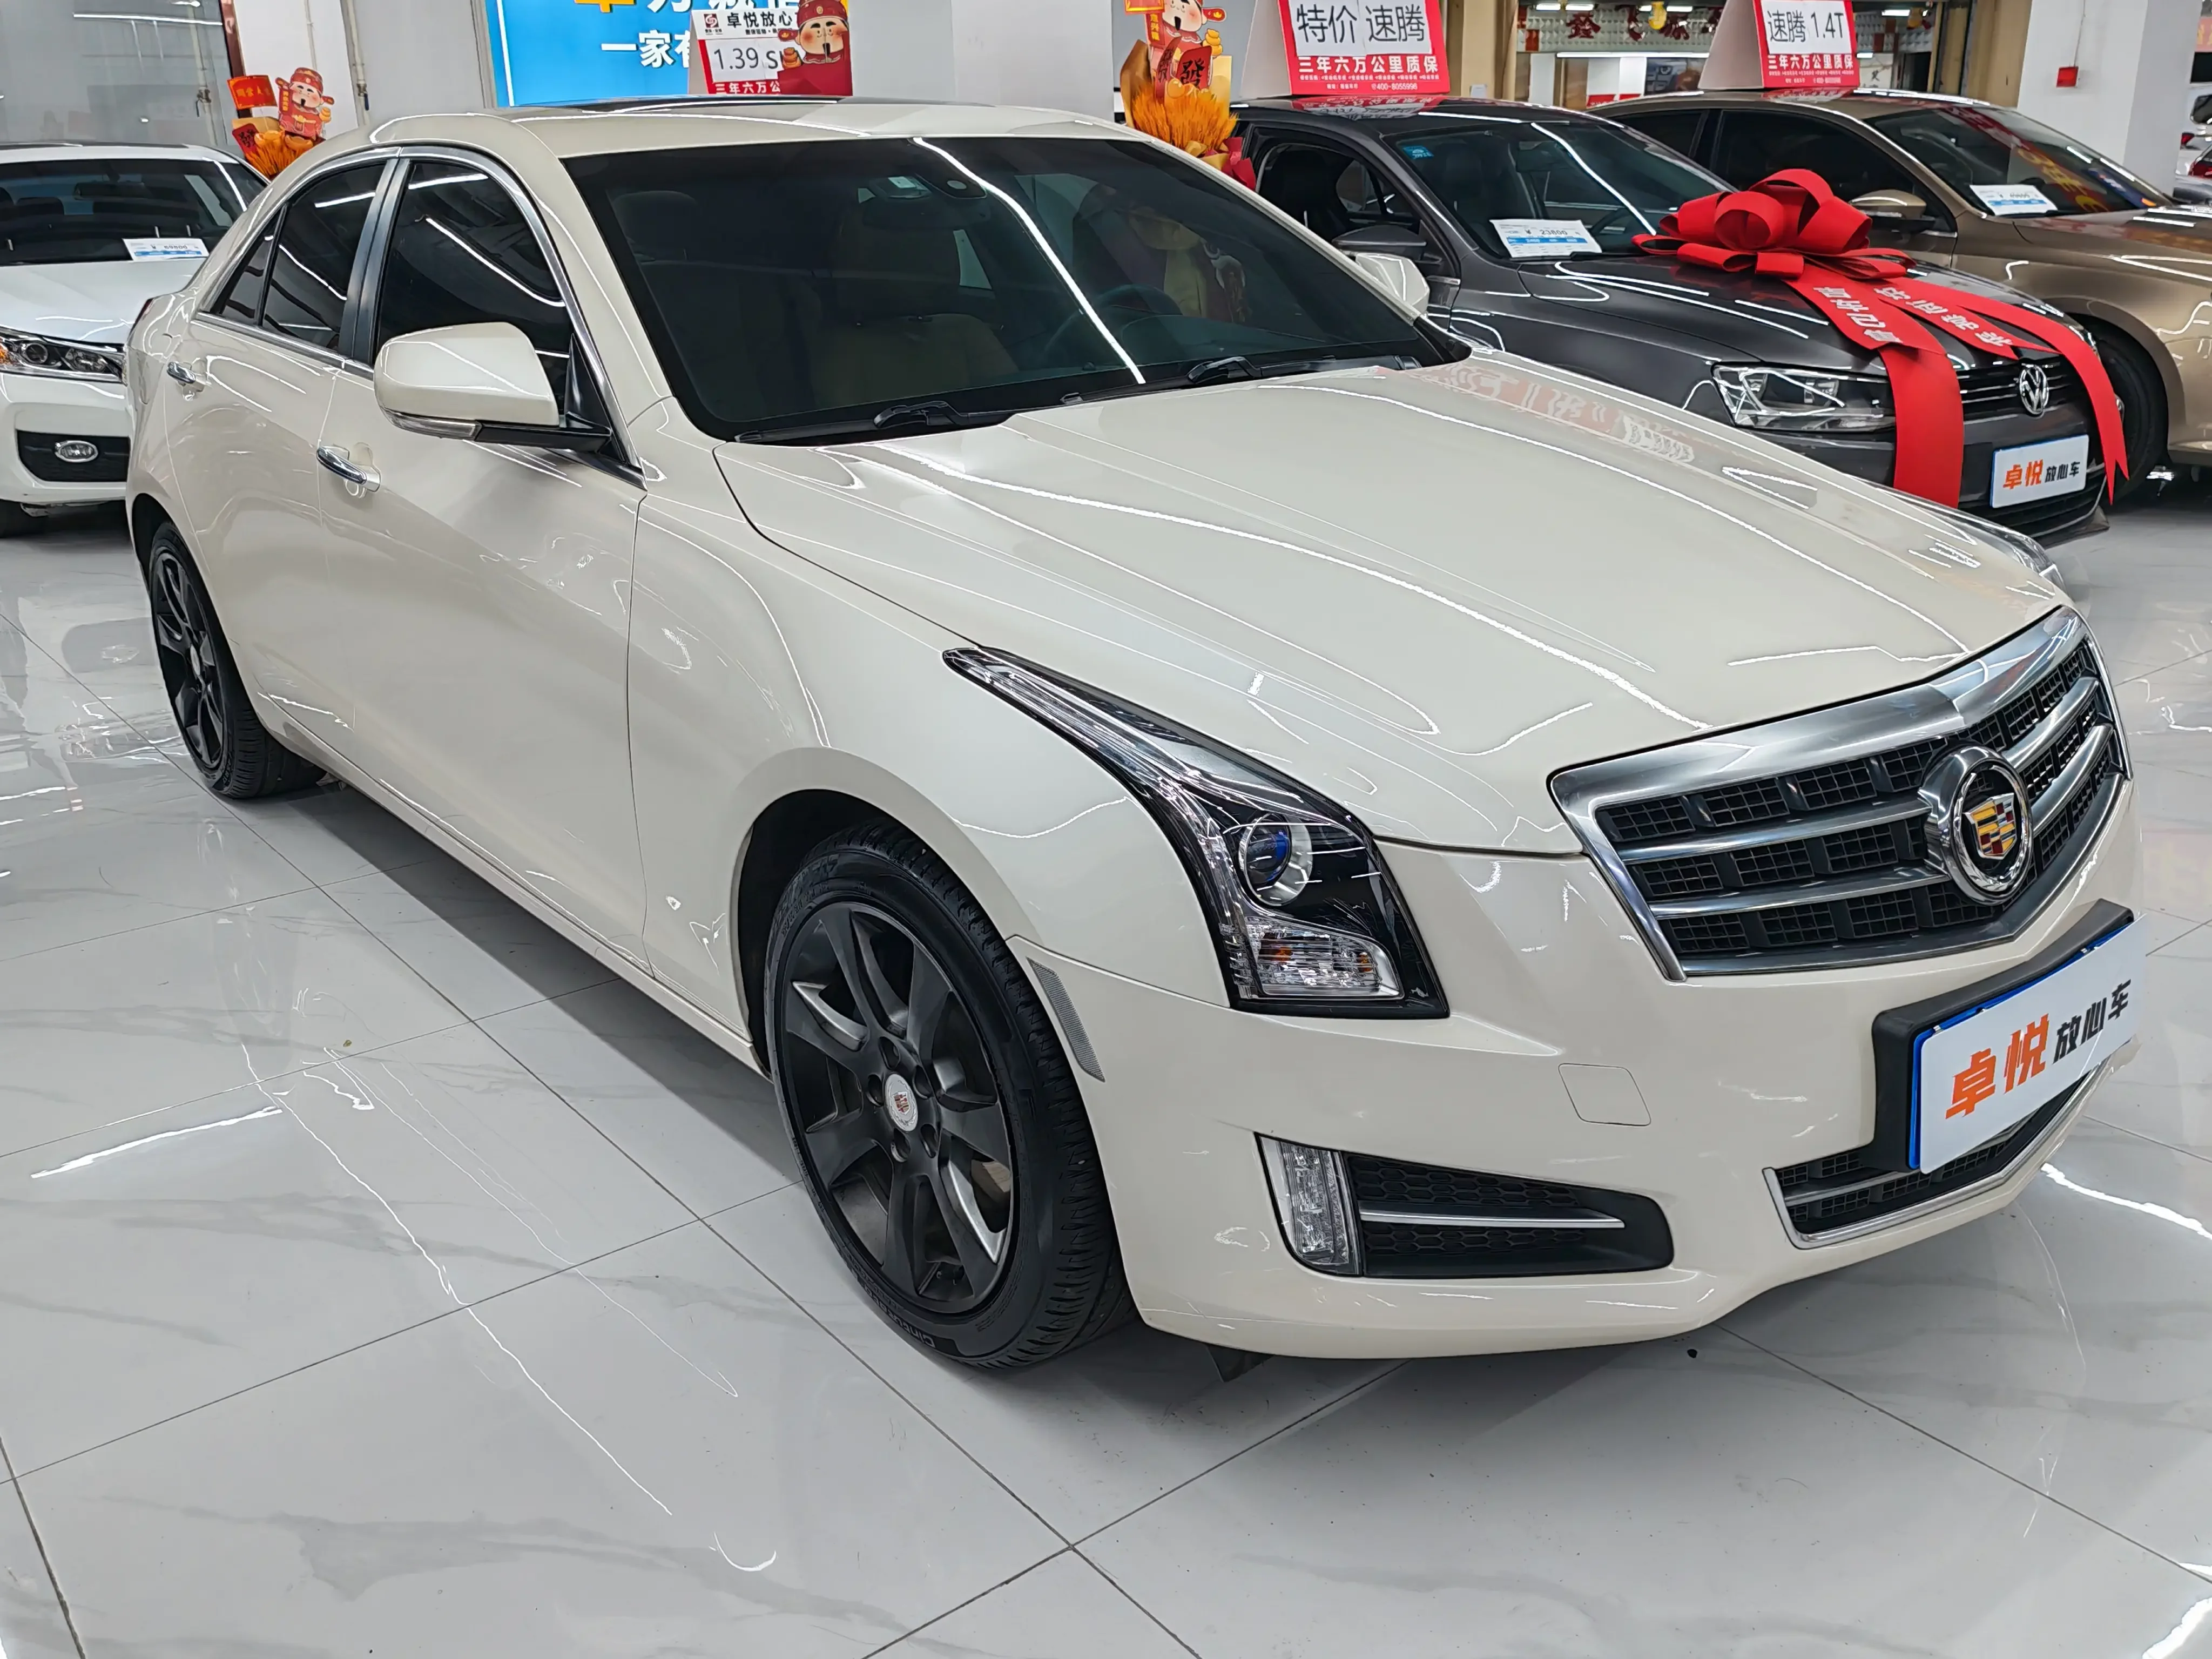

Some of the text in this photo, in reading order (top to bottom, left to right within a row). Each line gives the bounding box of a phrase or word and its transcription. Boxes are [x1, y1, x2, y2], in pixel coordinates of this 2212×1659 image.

[727, 11, 796, 28] 卓悦放心
[1297, 4, 1425, 43] 特价 速腾
[1767, 9, 1844, 43] 速腾 1.4T
[714, 47, 759, 70] 1.39
[1298, 56, 1439, 73] 三年六万公里质保
[1768, 55, 1854, 70] 三年六万公里质保
[2002, 459, 2080, 490] 卓悦放心车
[1945, 979, 2131, 1120] 卓悦放心车
